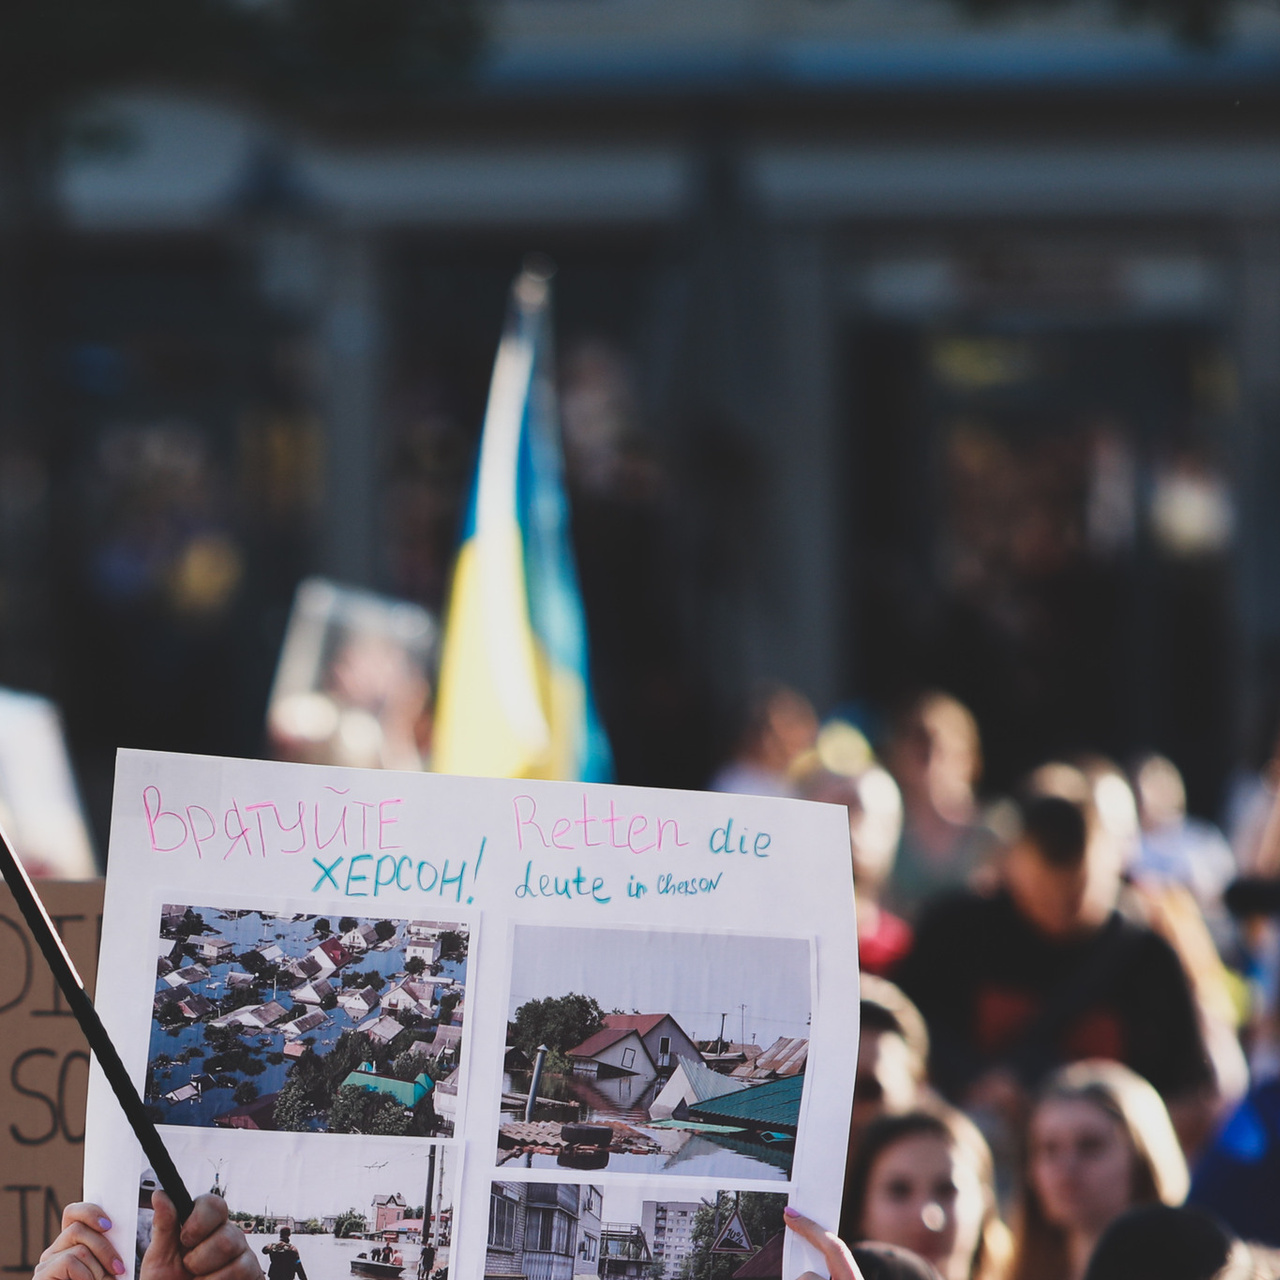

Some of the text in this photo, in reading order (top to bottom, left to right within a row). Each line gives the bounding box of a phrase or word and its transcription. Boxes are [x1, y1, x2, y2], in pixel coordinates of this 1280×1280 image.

[142, 785, 405, 861] ВРЯТУЙТЕ
[513, 793, 772, 859] Retten die
[311, 836, 488, 905] ХЕРСОН!
[627, 874, 648, 899] in
